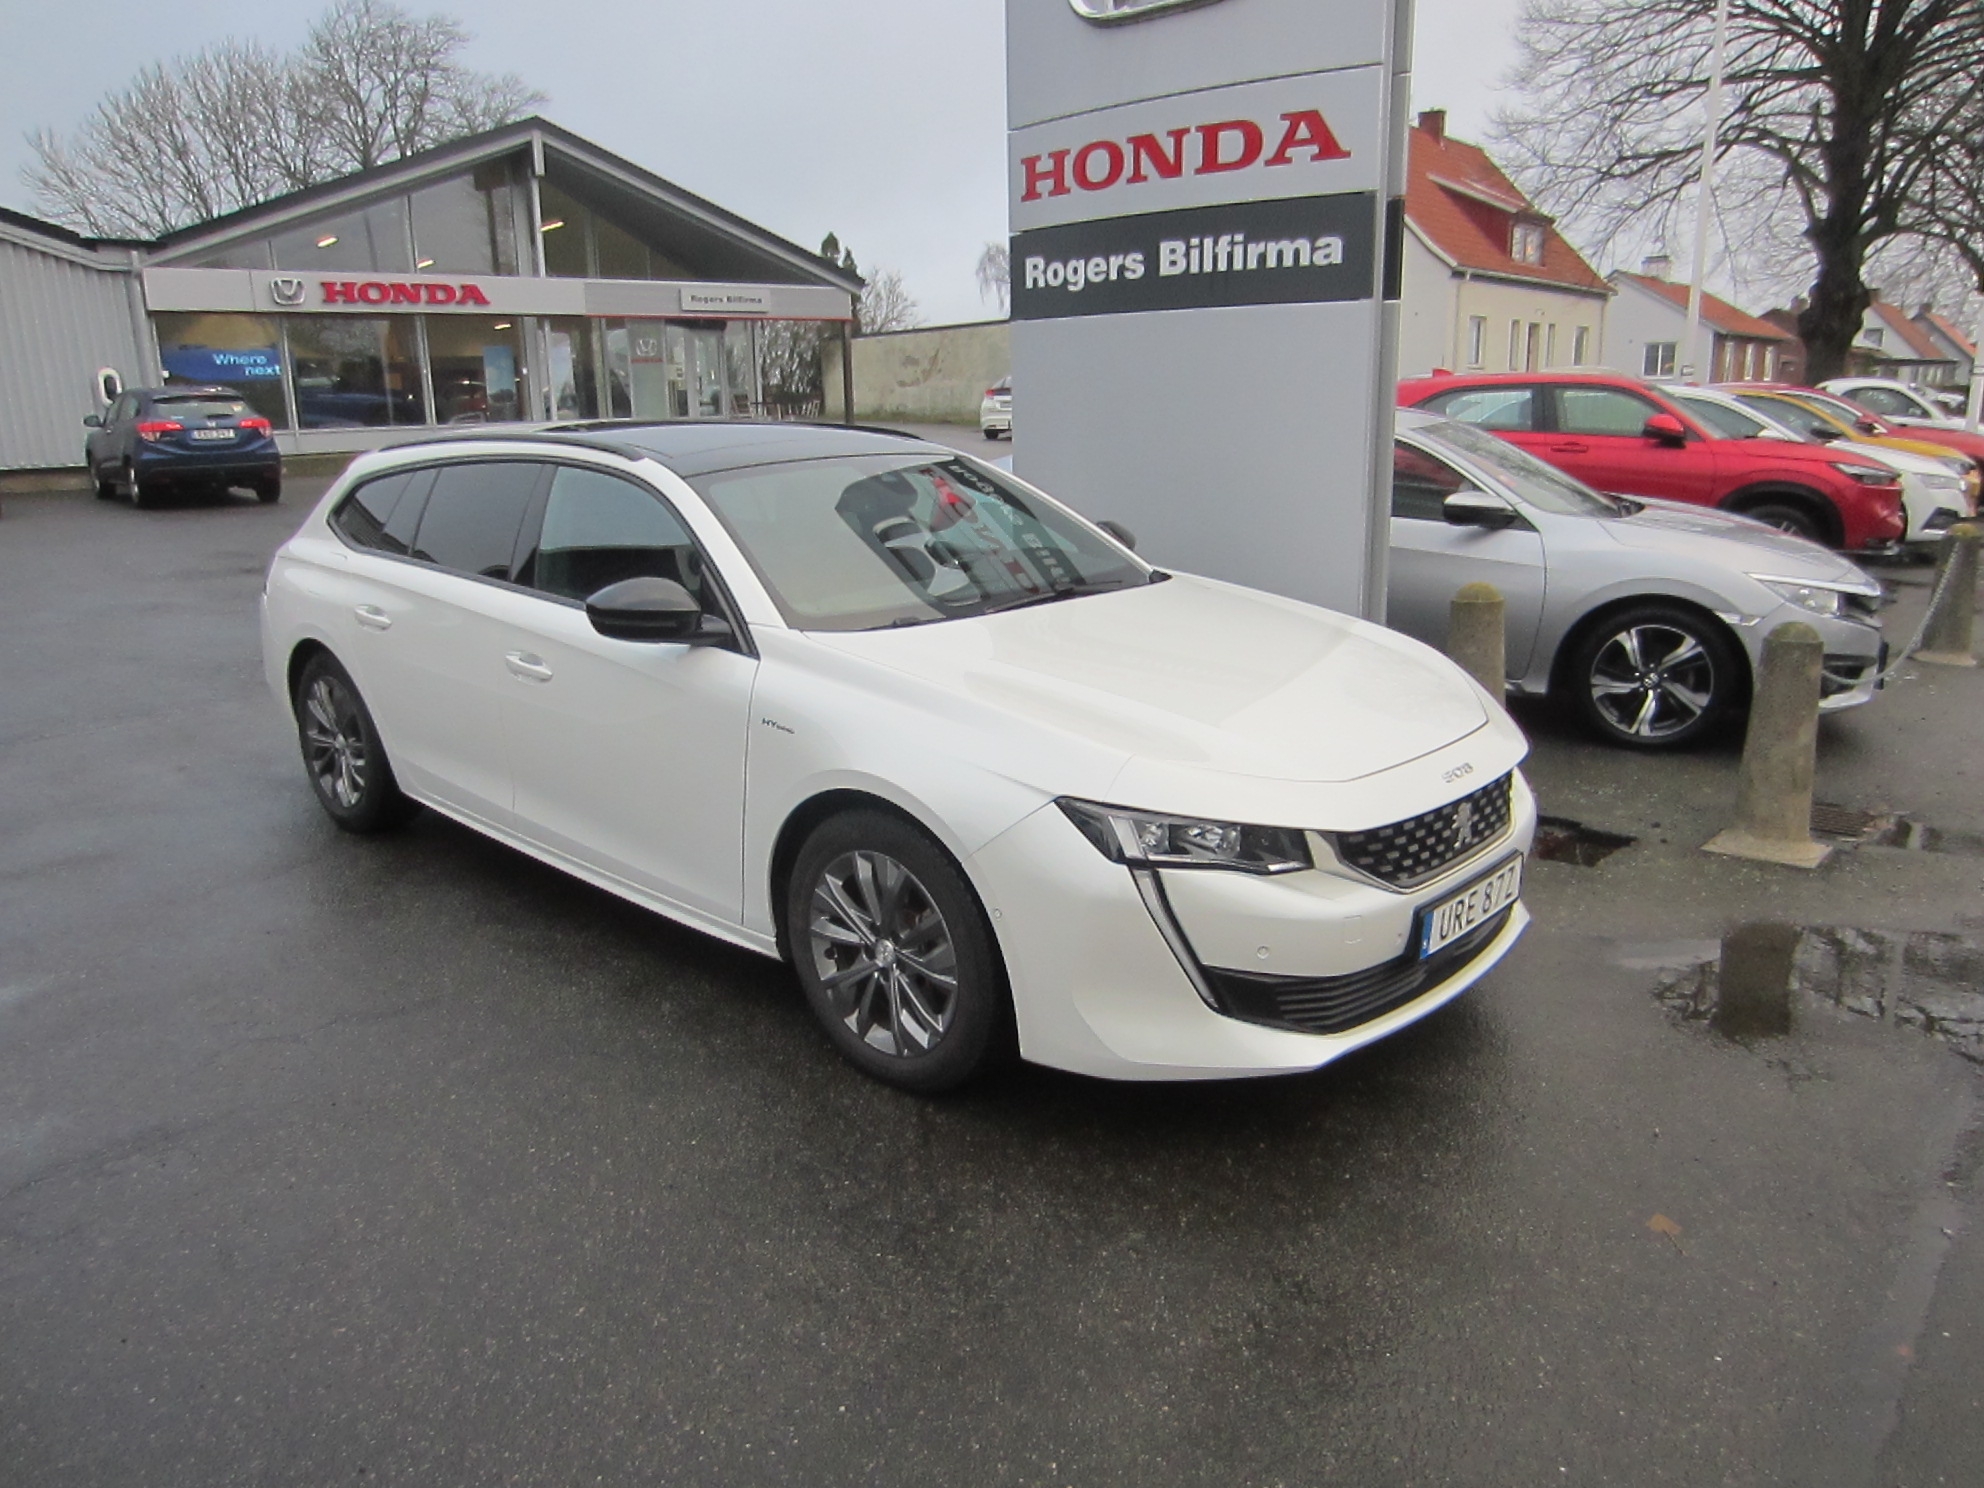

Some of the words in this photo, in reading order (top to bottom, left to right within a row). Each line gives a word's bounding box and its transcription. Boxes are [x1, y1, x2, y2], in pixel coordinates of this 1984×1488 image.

[1020, 109, 1352, 203] HONDA
[1024, 251, 1145, 292] Rogers
[1158, 233, 1344, 277] Bilfirma
[320, 281, 490, 306] HONDA
[690, 294, 723, 304] Rogers
[726, 295, 763, 304] Bilfirma
[212, 353, 268, 366] Where
[244, 364, 282, 376] next
[1441, 762, 1474, 784] 508
[1439, 889, 1478, 940] URE
[1481, 865, 1516, 914] 87Z
